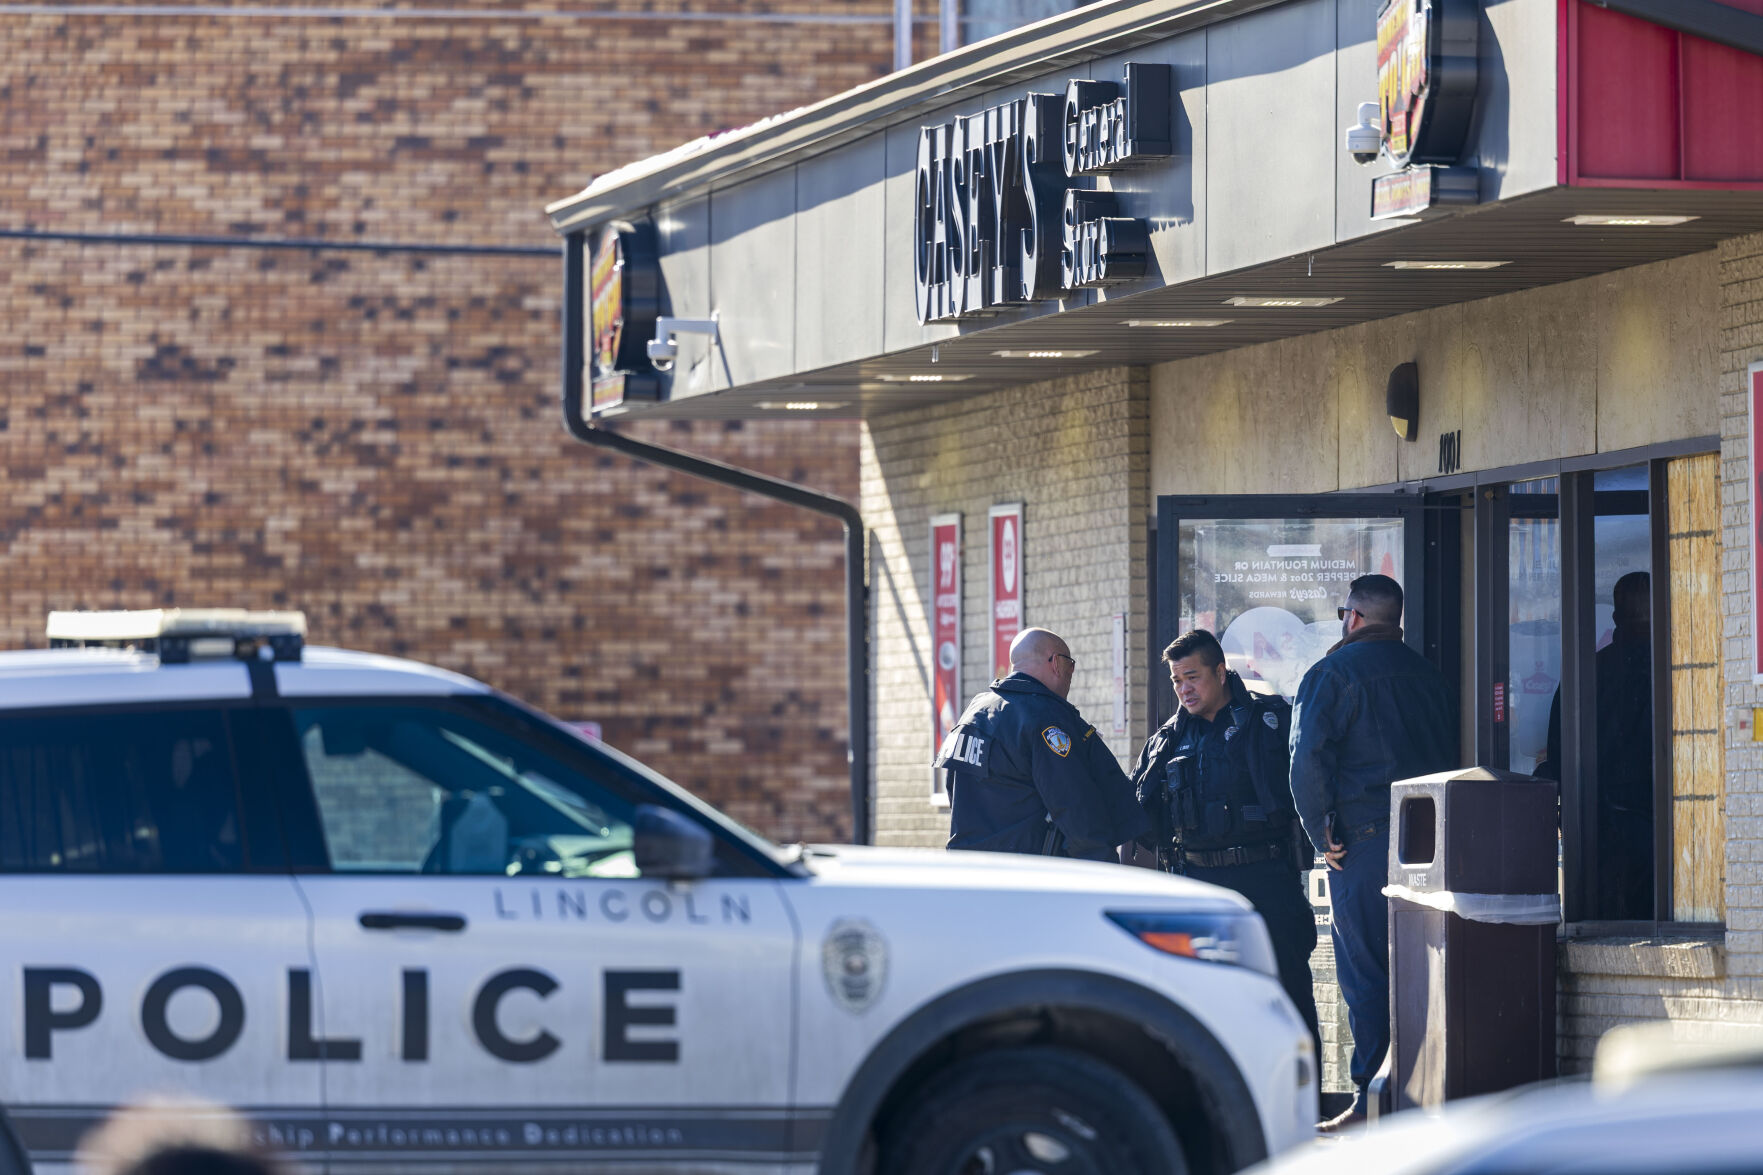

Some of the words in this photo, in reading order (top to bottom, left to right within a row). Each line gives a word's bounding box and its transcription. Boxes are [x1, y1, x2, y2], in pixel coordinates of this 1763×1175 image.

[1063, 62, 1134, 178] General
[914, 91, 1043, 327] CASEY'S
[1061, 188, 1110, 290] Store
[1438, 429, 1461, 474] 1001
[492, 887, 753, 925] LINCOLN
[1408, 873, 1427, 887] WASTE
[22, 966, 684, 1063] POLICE
[327, 1121, 512, 1147] Performance
[523, 1121, 684, 1146] Dedication
